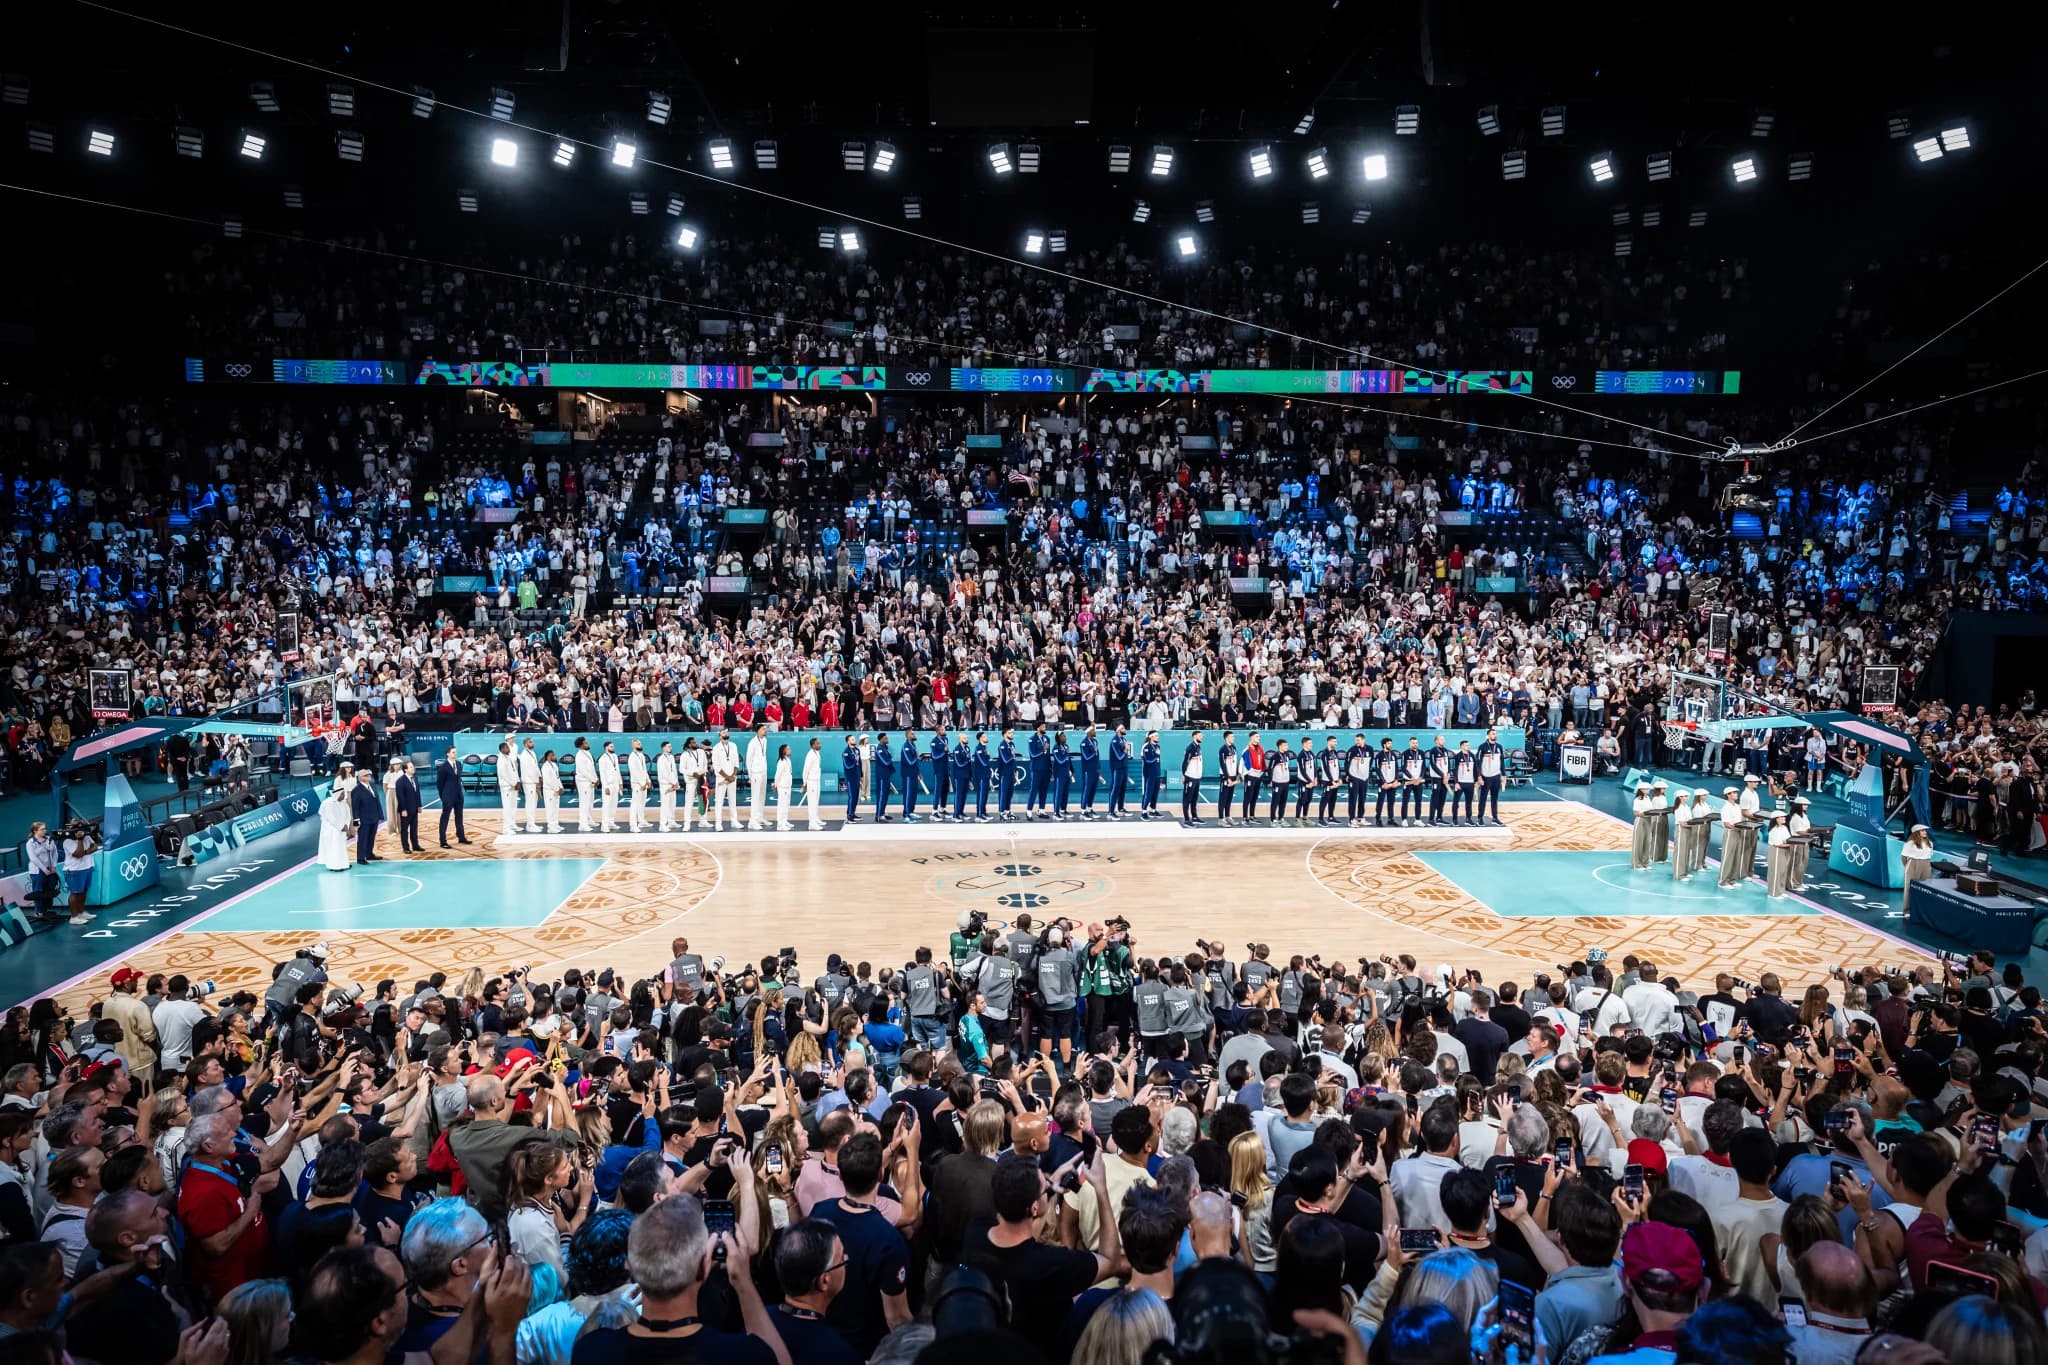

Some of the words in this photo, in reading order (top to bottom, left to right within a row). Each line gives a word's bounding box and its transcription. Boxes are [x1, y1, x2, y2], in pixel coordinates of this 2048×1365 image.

[1022, 375, 1064, 386] 2024
[1664, 377, 1706, 389] 2024
[1566, 755, 1587, 766] FIBA
[911, 849, 1012, 866] PARIS
[1031, 849, 1121, 865] 2024
[187, 859, 276, 891] 2024
